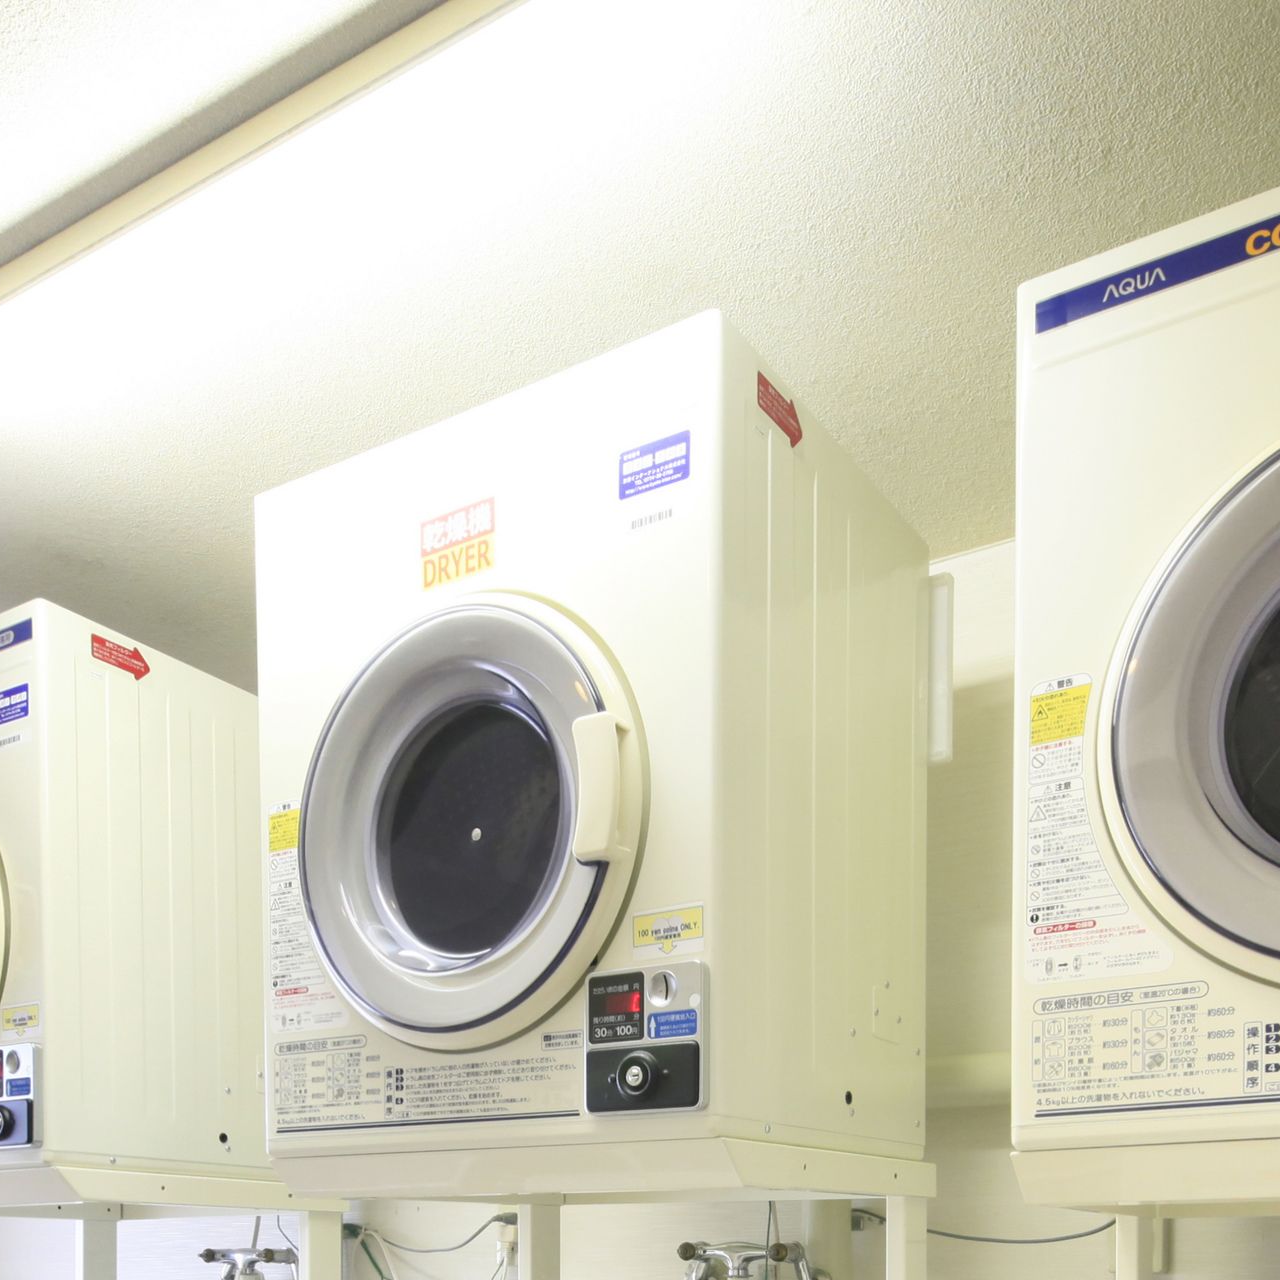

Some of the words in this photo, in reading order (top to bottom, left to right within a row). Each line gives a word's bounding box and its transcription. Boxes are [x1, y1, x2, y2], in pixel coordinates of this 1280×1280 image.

[1102, 267, 1166, 303] AQUA
[423, 540, 491, 588] DRYER
[1041, 992, 1134, 1012] 乾燥時間の目安
